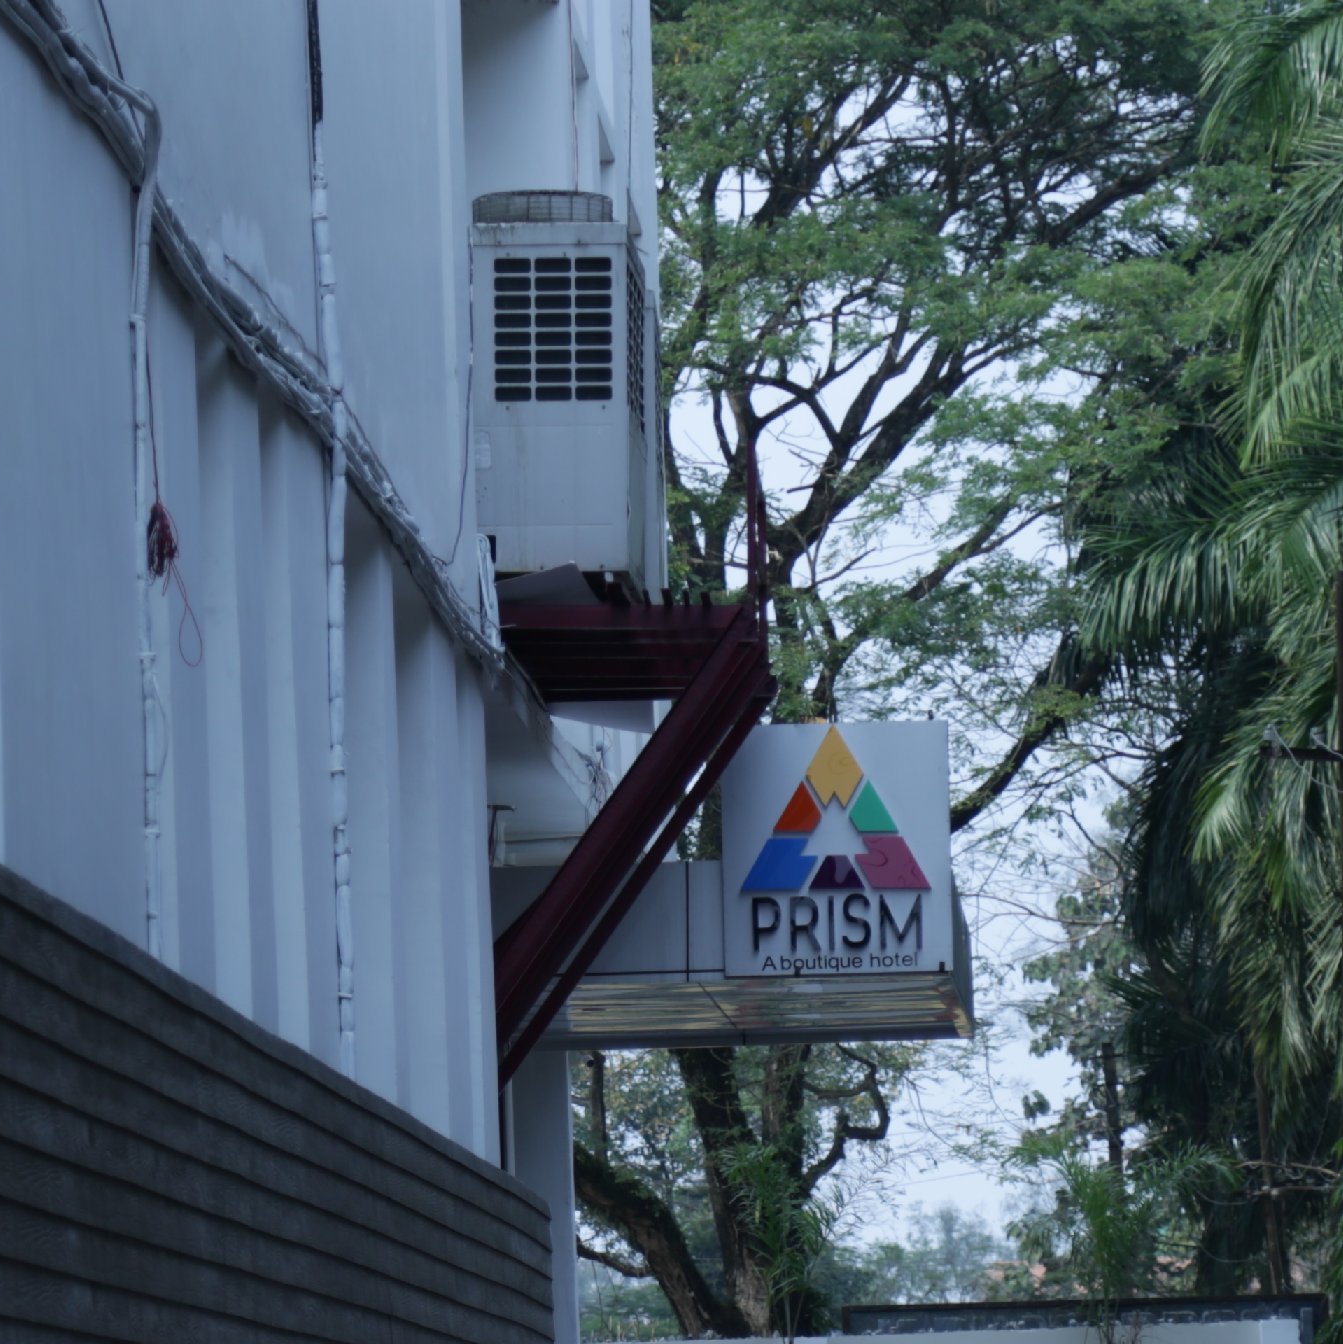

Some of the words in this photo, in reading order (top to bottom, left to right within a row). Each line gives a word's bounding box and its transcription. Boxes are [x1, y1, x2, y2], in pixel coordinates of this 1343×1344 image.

[752, 893, 924, 954] PRISM
[762, 956, 777, 971] A
[780, 955, 863, 972] boutique
[870, 951, 919, 968] hotel
